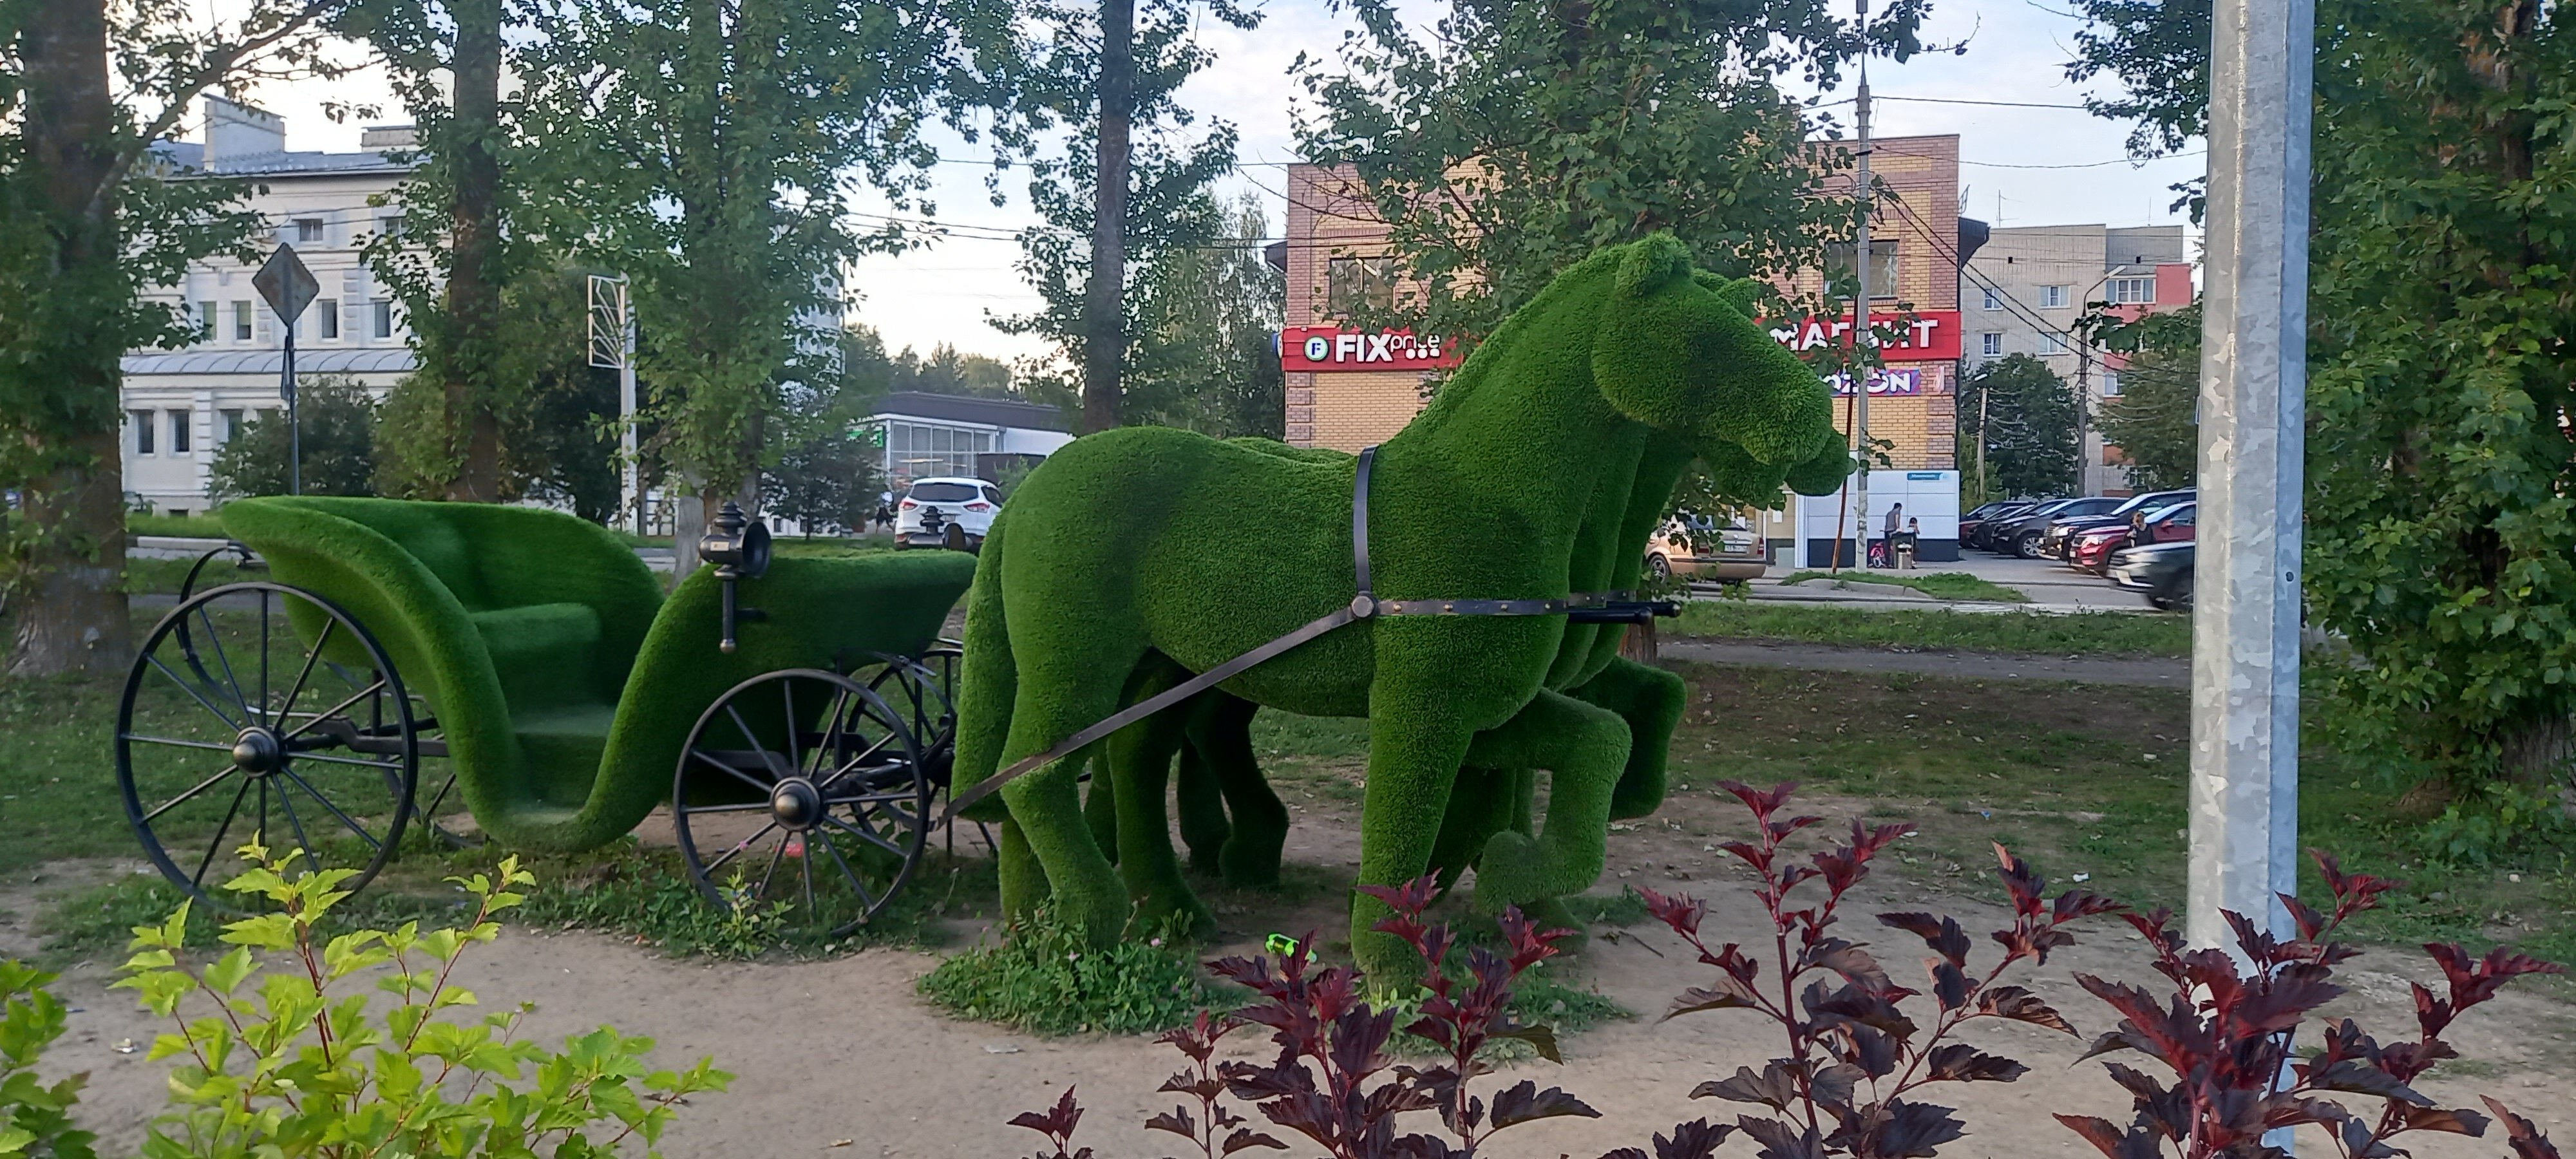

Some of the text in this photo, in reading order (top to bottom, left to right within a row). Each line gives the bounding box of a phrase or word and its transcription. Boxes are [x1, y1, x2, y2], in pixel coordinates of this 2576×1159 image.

[1311, 343, 1321, 355] F
[1335, 334, 1393, 362] FIX
[1769, 319, 1938, 351] МАГТ
